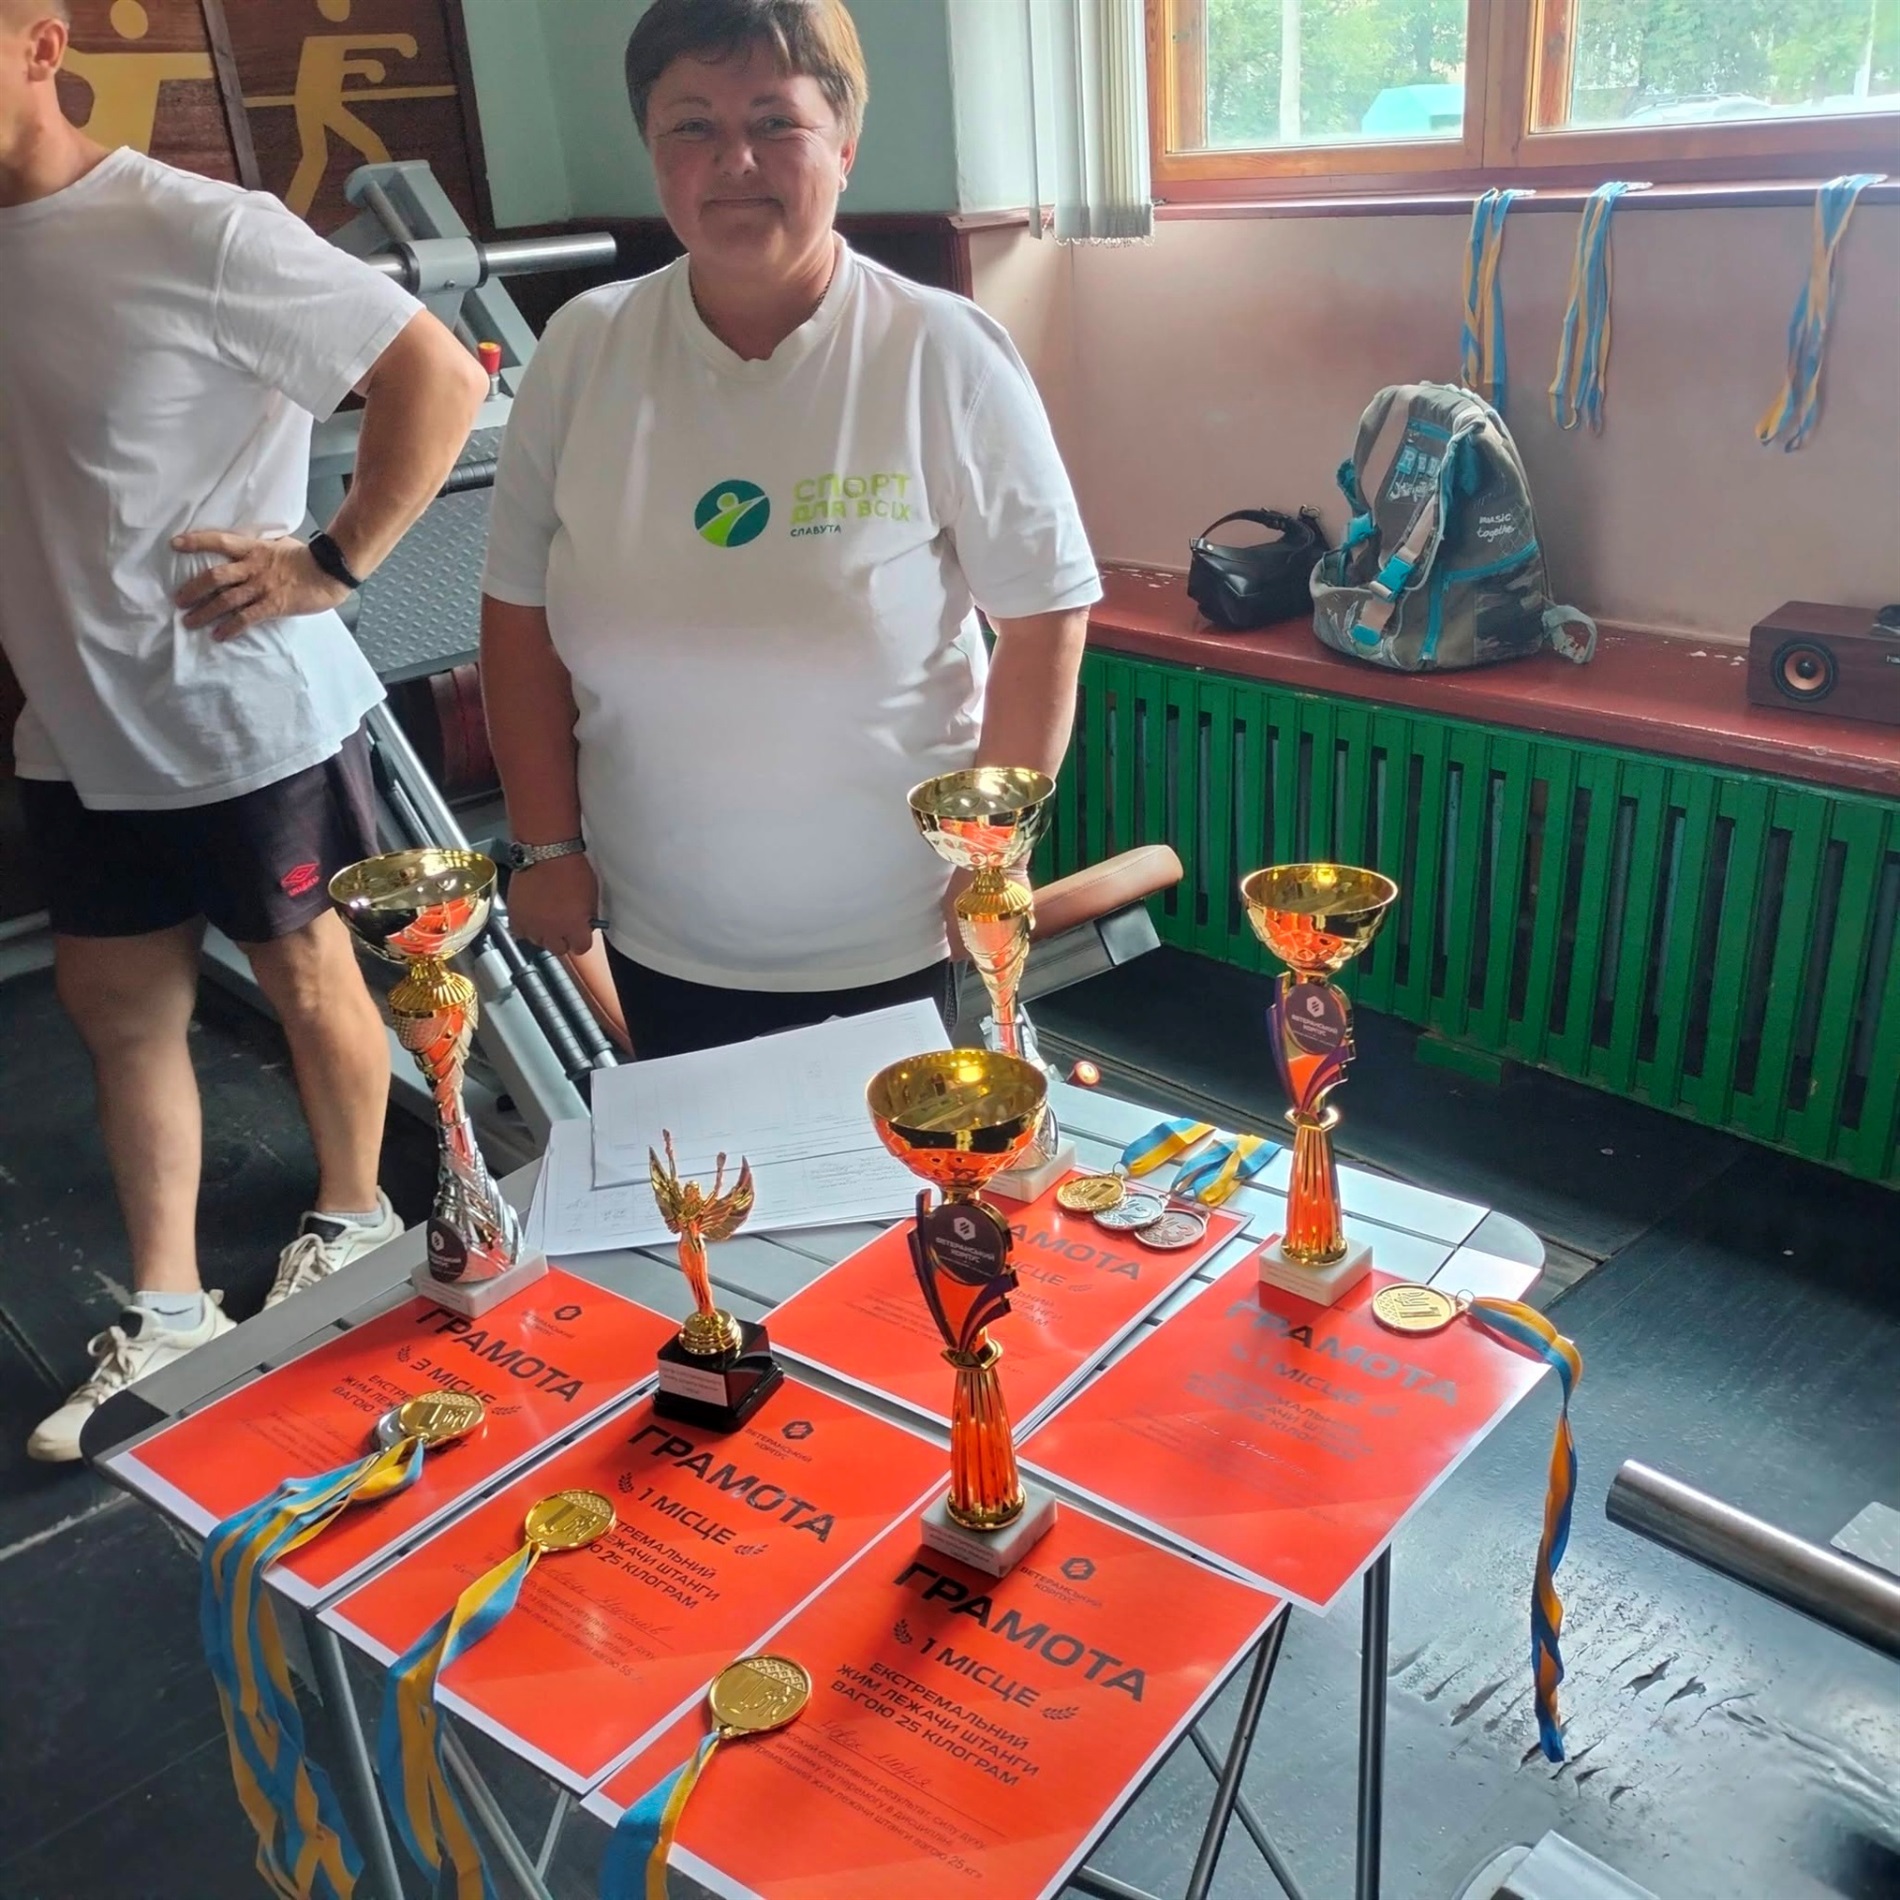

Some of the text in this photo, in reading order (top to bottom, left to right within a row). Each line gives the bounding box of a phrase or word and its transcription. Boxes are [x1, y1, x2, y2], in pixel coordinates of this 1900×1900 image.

[789, 499, 911, 525] ДЛЯ ВСІХ
[792, 473, 911, 500] СПОРТ
[790, 524, 842, 537] СЛАВУТА
[1009, 1223, 1140, 1281] АМОТА
[415, 1308, 586, 1404] ГРАМОТА
[1224, 1298, 1460, 1407] ГРАМОТА
[332, 1386, 375, 1412] ВАГОЮ
[342, 1375, 373, 1393] ЖИМ
[627, 1424, 839, 1545] ГРАМОТА
[637, 1486, 737, 1546] 1 МІСЦЕ
[597, 1550, 624, 1566] 25
[621, 1561, 699, 1610] КІЛОГРАМ
[603, 1533, 658, 1567] ЕЖАЧИ
[656, 1562, 720, 1602] ШТАНГИ
[614, 1518, 717, 1580] ТРЕМАЛЬНИЙ
[893, 1560, 1152, 1704] ГРАМОТА
[919, 1636, 1042, 1709] 1 МІСЦЕ
[830, 1679, 1020, 1787] ВАГОЮ 25 КІЛОГРАМ
[836, 1664, 1040, 1777] ЖИМ ЛЕЖАЧИ ШТАНГИ
[868, 1661, 1031, 1751] ЕКСТРЕМАЛЬНИЙ
[947, 1854, 965, 1871] 25
